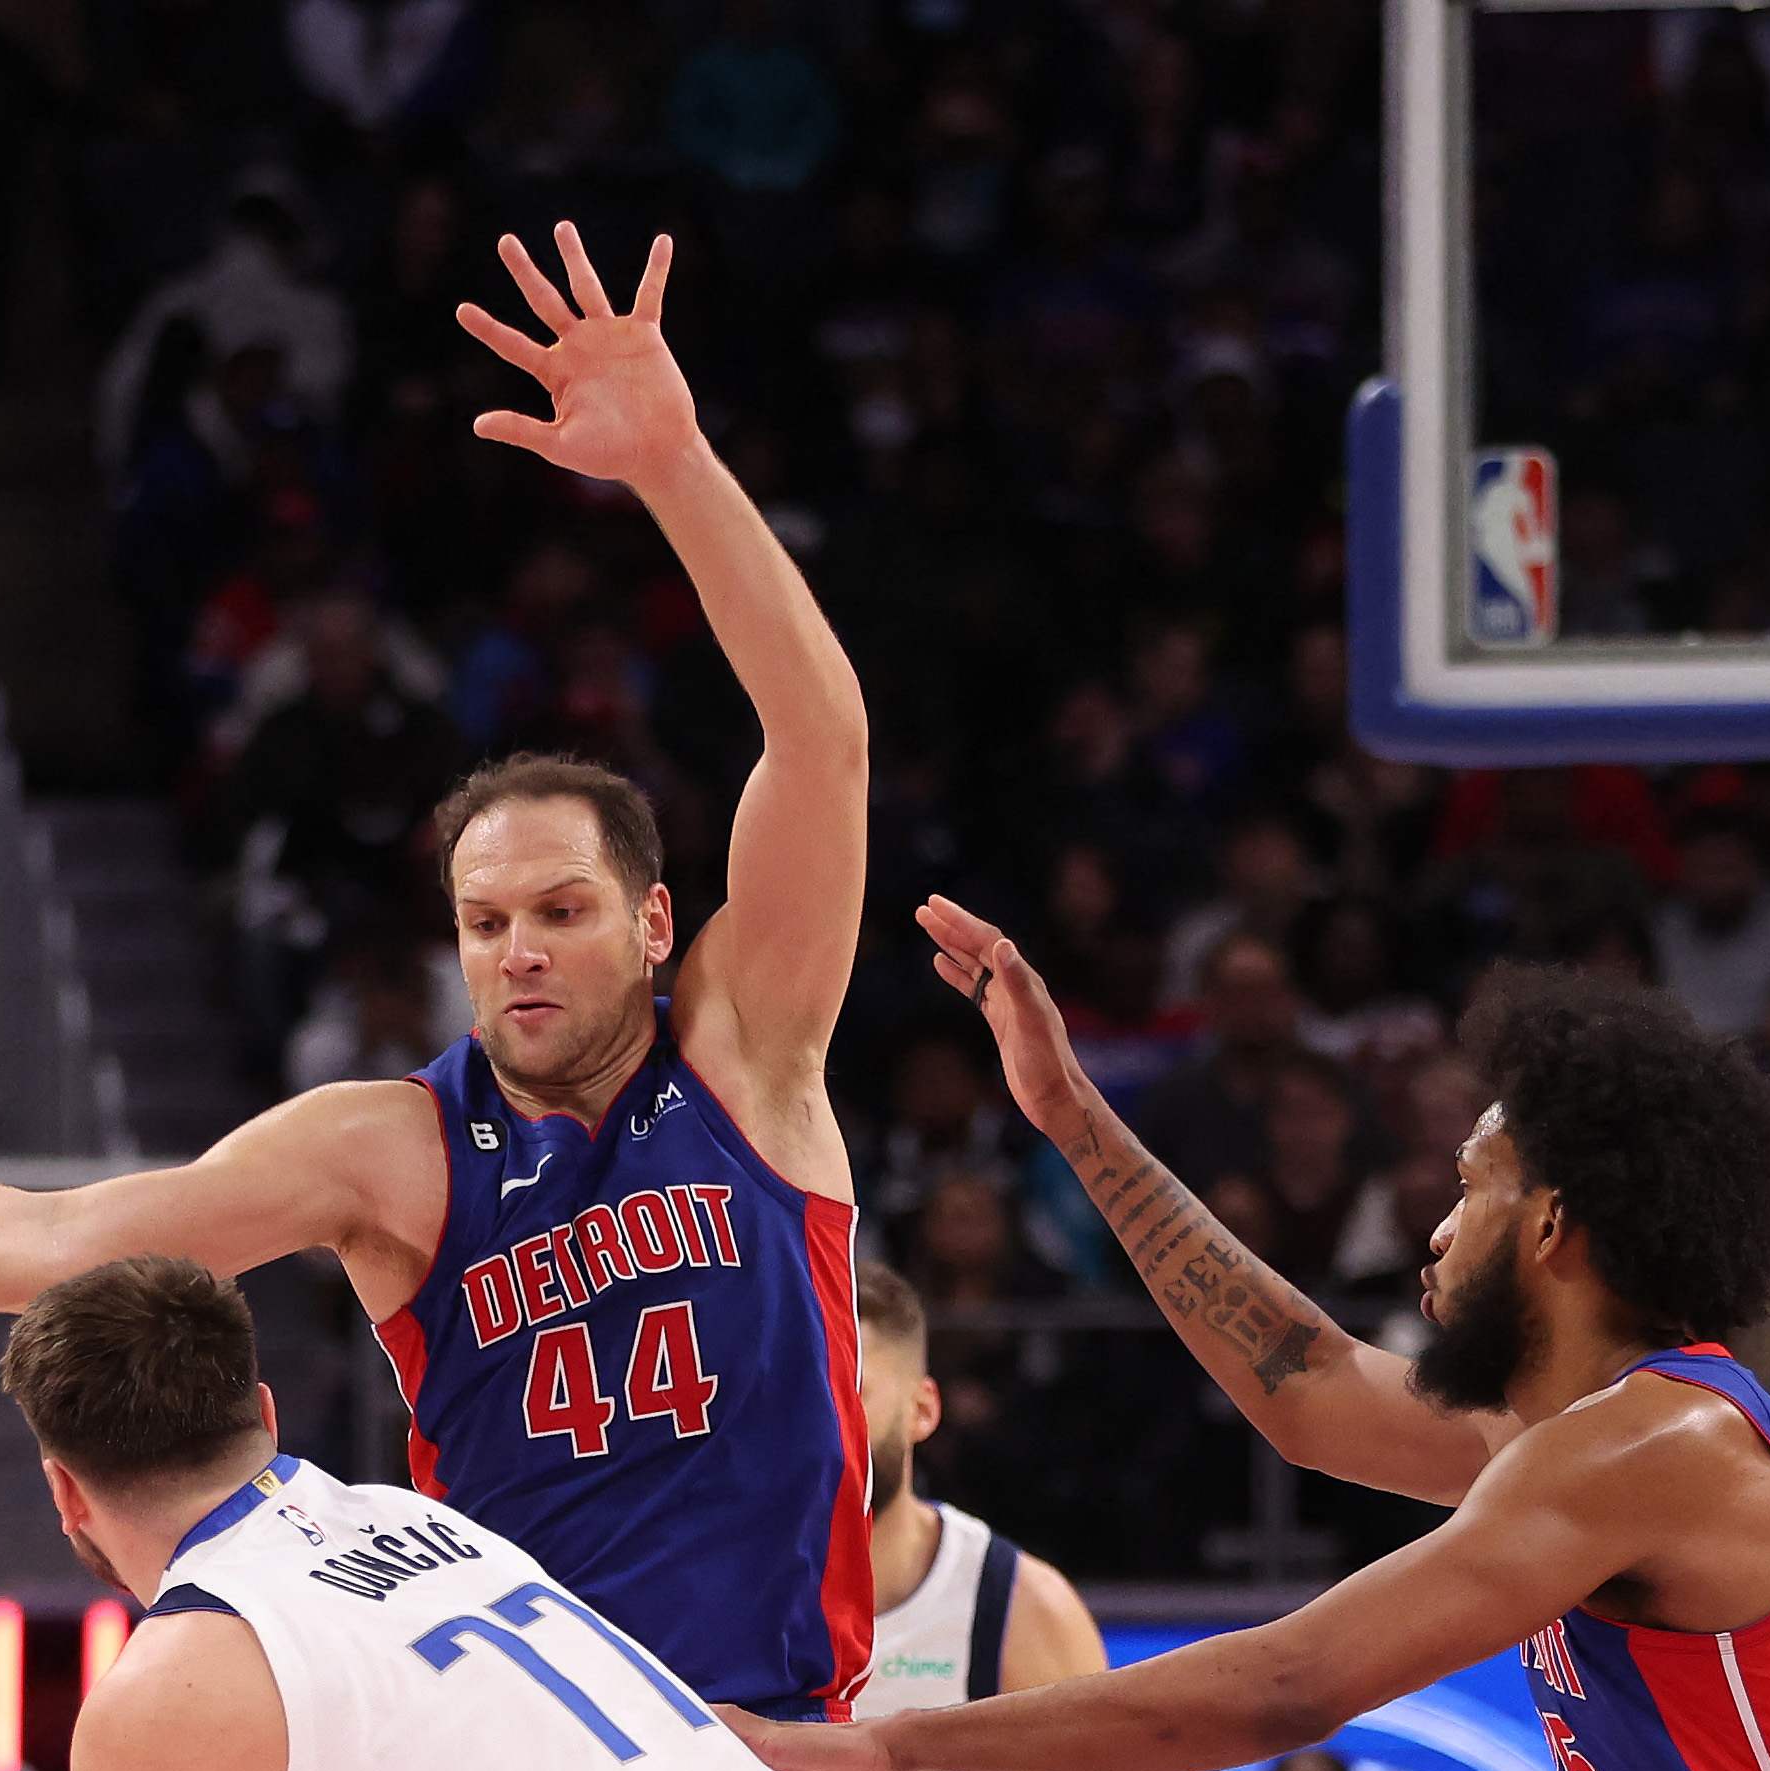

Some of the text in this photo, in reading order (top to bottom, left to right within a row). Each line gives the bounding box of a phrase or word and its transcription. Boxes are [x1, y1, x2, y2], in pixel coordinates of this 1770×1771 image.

[470, 1122, 499, 1150] 6
[630, 1081, 684, 1136] UM
[462, 1183, 742, 1350] DETROIT
[522, 1299, 719, 1460] 44
[309, 1514, 483, 1602] DONČIĆ
[406, 1581, 719, 1765] 77
